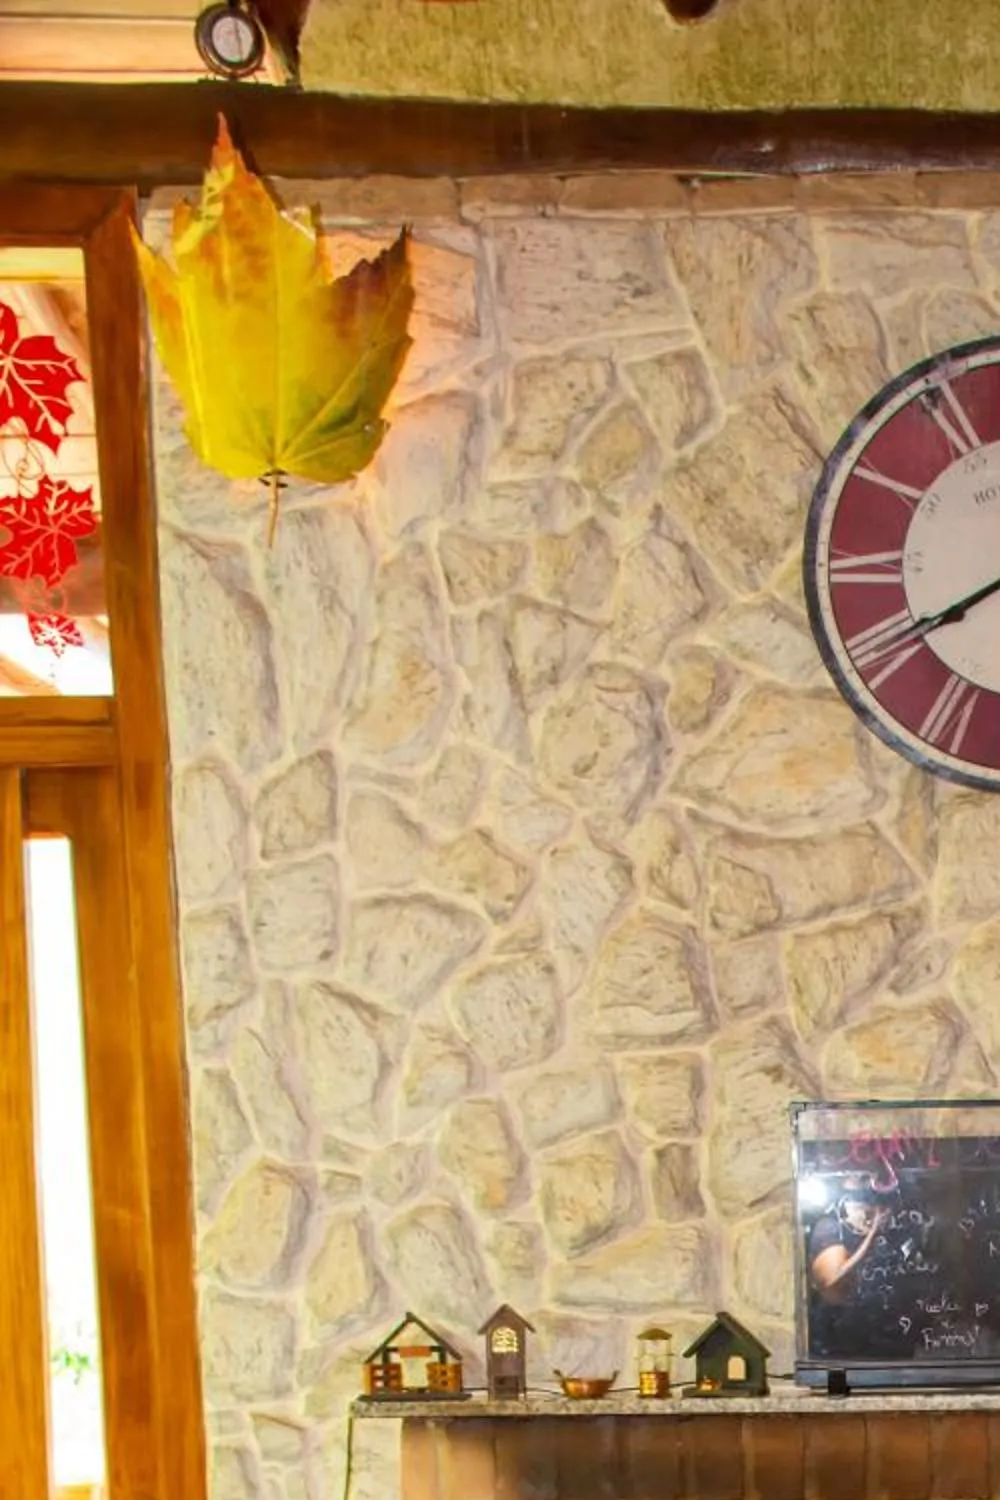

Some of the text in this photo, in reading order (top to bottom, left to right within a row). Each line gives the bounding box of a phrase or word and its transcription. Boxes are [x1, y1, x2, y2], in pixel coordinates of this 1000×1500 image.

[921, 378, 983, 462] XI
[853, 456, 924, 512] X
[829, 548, 903, 583] IX
[919, 672, 981, 756] VII
